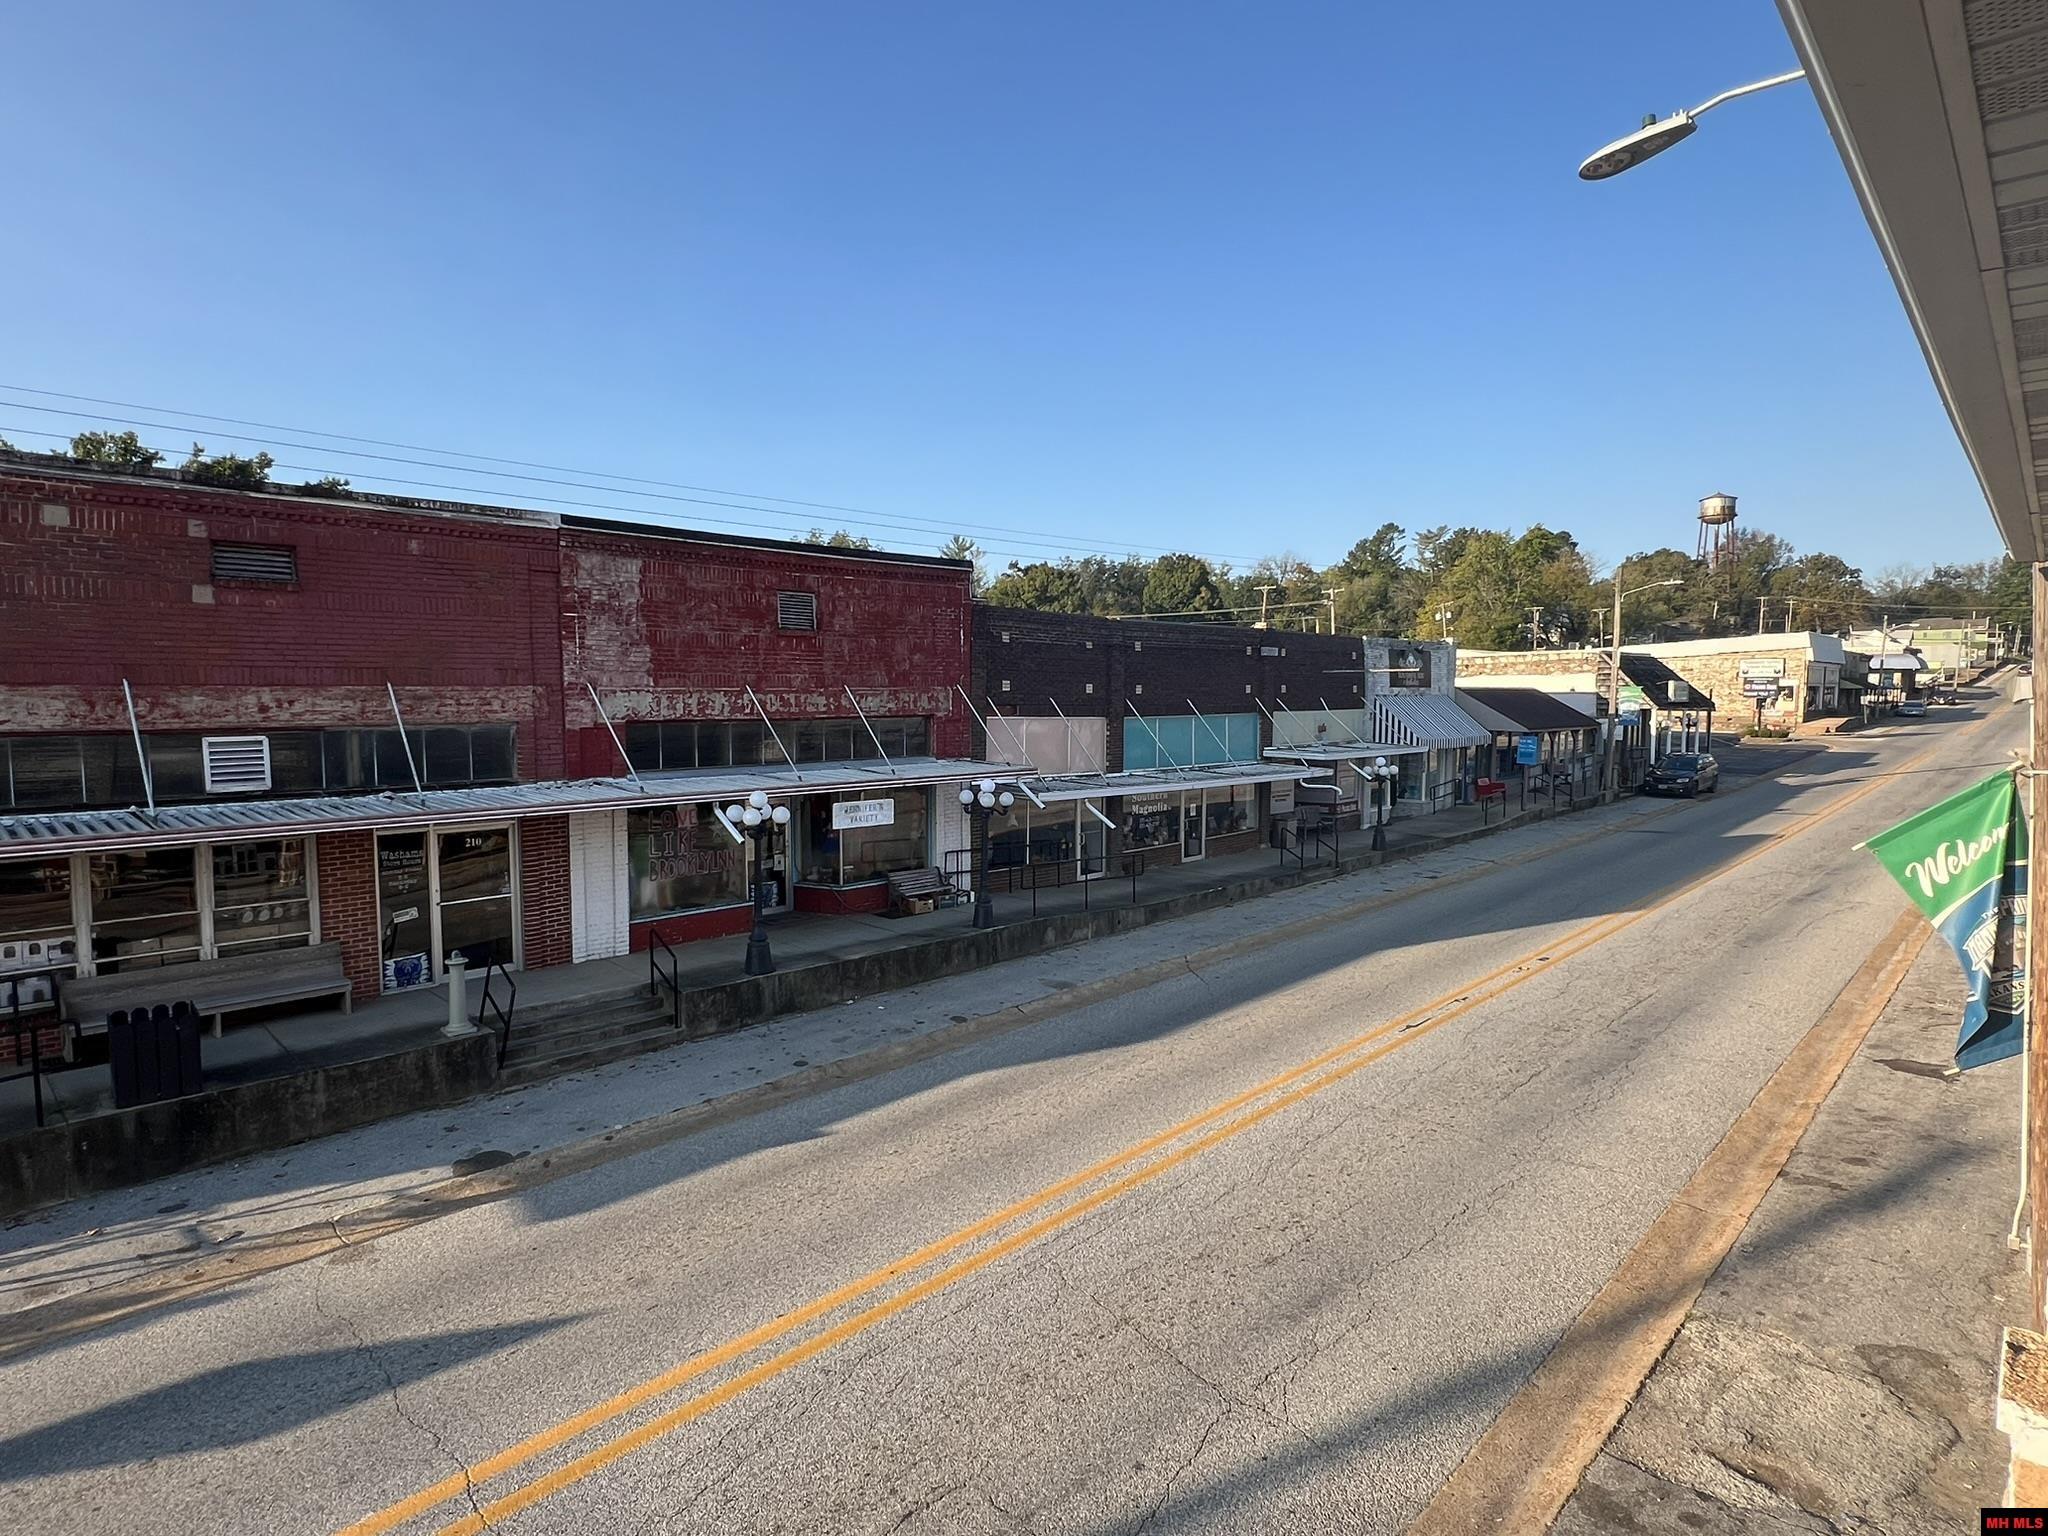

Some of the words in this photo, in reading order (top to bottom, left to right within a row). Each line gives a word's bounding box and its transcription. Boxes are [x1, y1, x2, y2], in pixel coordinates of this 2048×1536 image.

[648, 808, 698, 832] LOVE
[465, 837, 482, 848] 210
[648, 829, 700, 858] LIKE
[1904, 822, 2010, 898] Welcom
